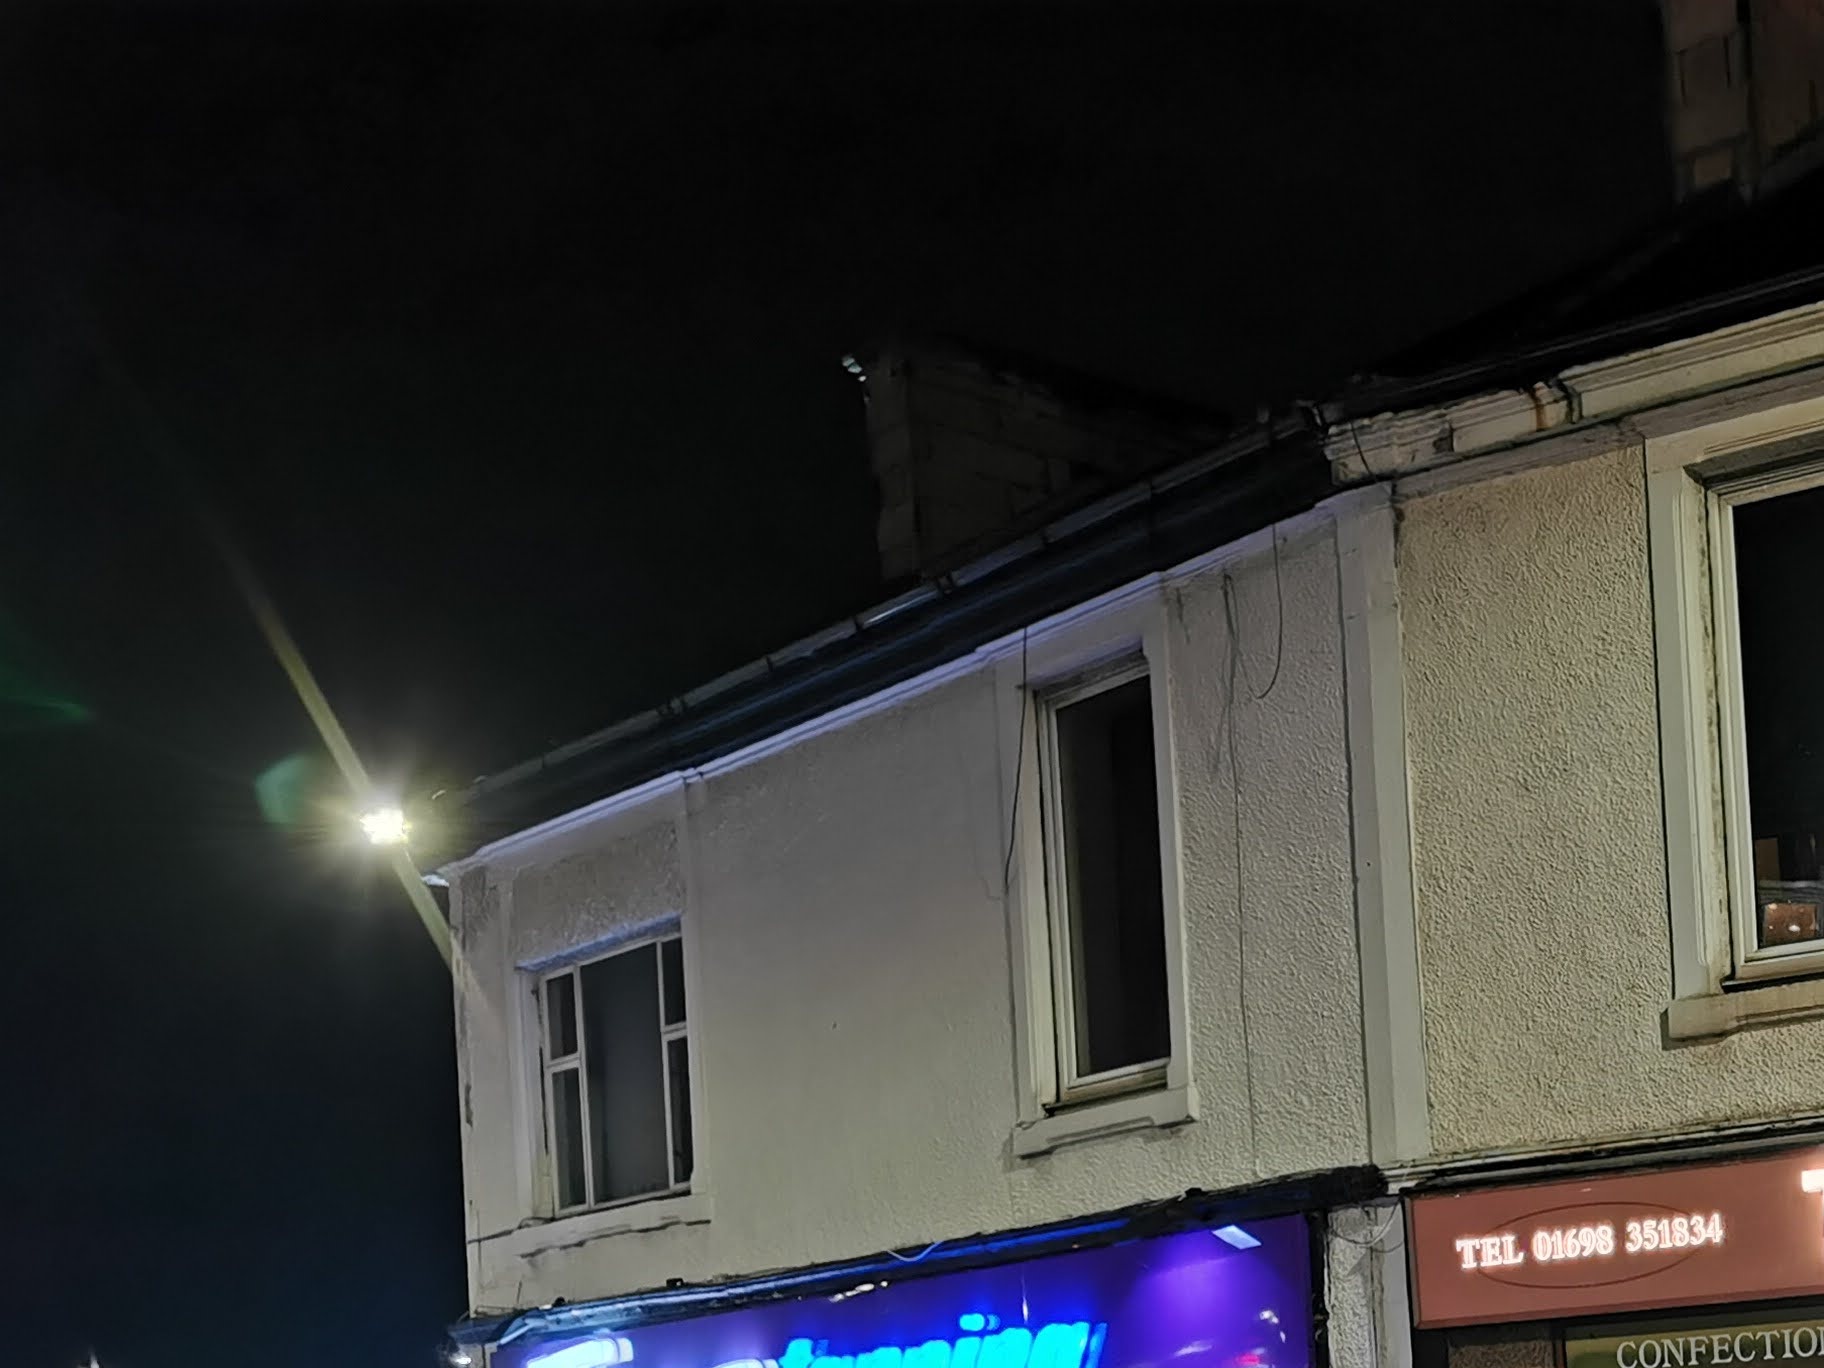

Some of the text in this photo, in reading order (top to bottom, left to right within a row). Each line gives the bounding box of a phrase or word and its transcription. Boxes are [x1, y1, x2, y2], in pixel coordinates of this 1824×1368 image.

[1456, 1212, 1723, 1269] TEL 01698 351834
